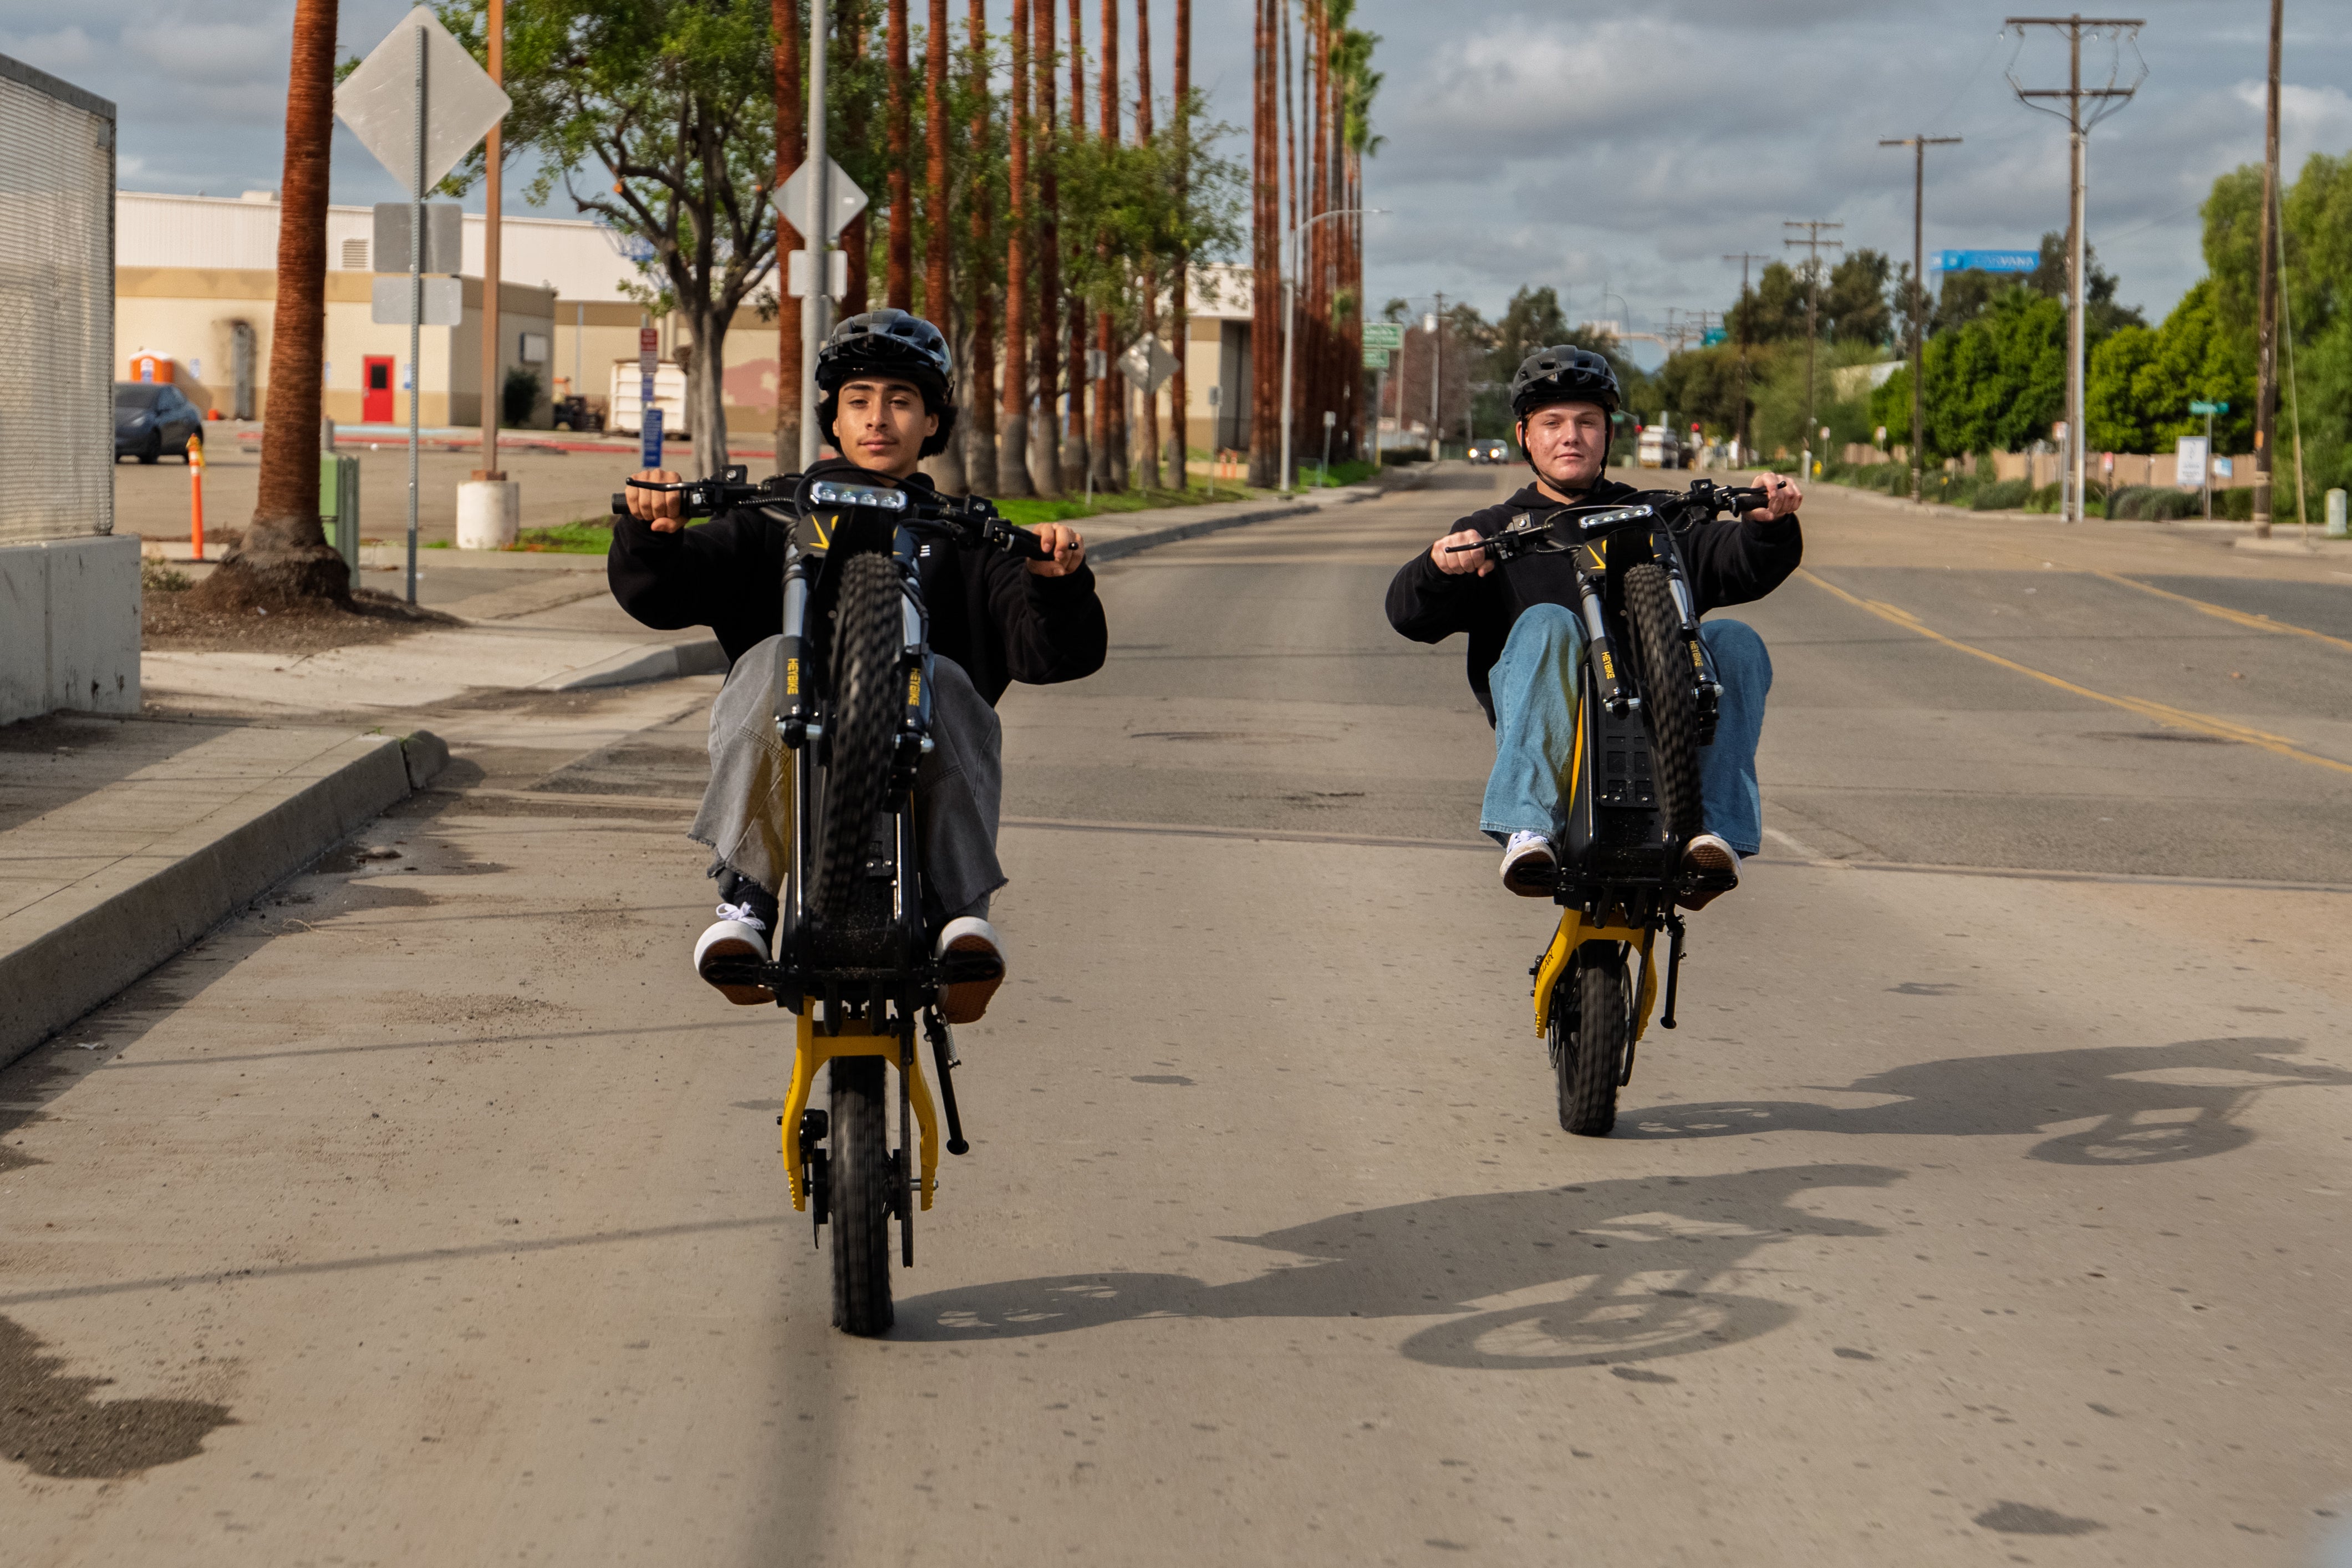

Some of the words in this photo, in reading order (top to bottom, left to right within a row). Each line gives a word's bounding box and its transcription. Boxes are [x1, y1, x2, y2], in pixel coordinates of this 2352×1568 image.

[1601, 651, 1615, 680] HEYBIKE
[1689, 640, 1704, 667] HEYBIKE
[787, 658, 798, 695] HEYBIKE
[908, 668, 921, 706] HEYBIKE
